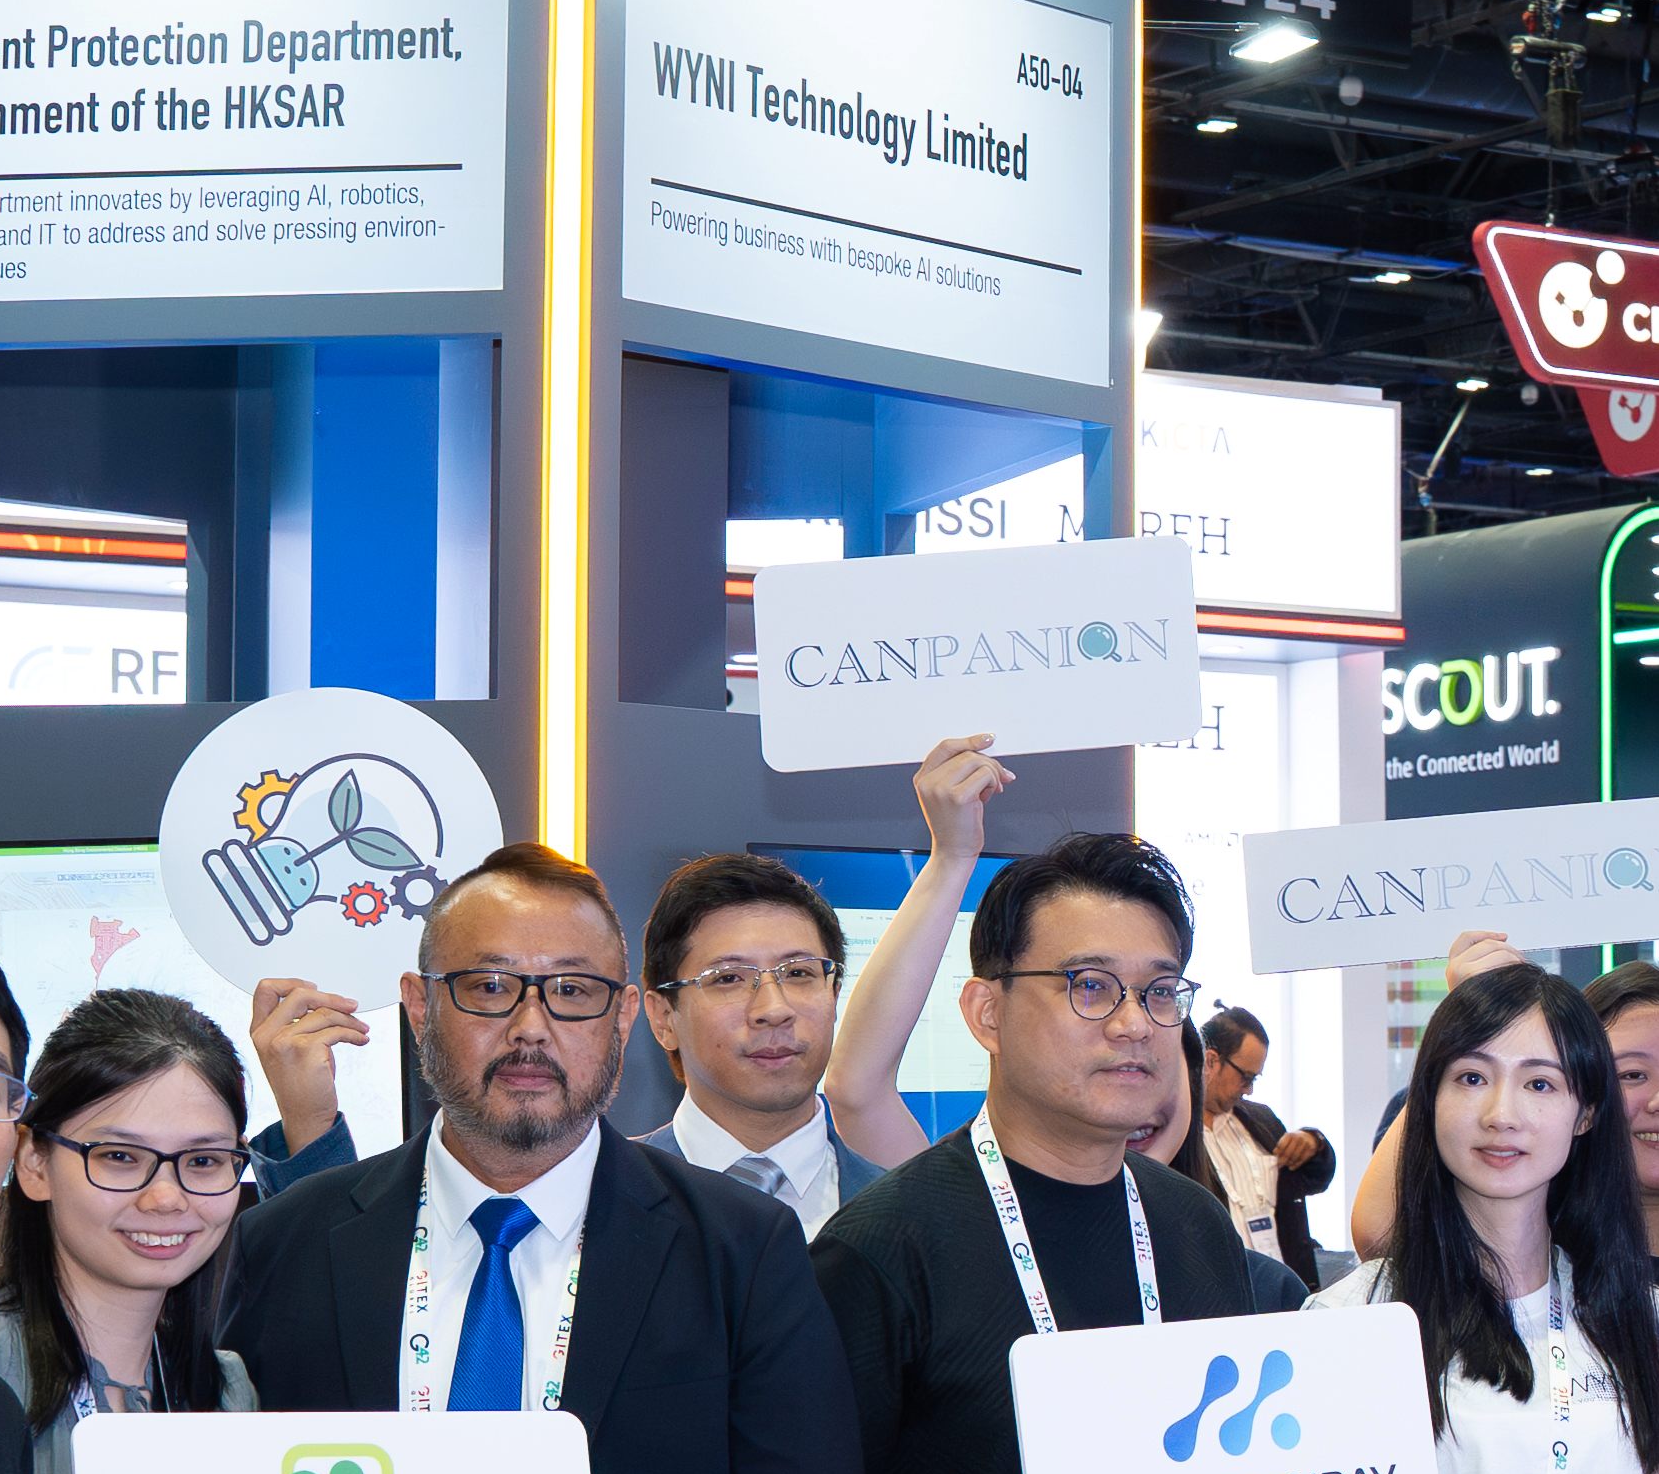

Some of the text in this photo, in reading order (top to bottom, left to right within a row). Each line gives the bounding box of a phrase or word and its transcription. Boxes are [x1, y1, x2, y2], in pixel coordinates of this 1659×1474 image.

[48, 23, 227, 68] Protection
[244, 19, 461, 70] Department,
[1017, 54, 1082, 100] A50-04
[112, 90, 145, 133] of
[155, 89, 209, 131] the
[225, 85, 344, 130] HKSAR
[654, 43, 1027, 182] WYNI Technology Limited
[71, 191, 161, 211] innovates
[171, 189, 191, 214] by
[200, 187, 299, 213] leveraging
[308, 186, 331, 209] AI,
[342, 184, 423, 206] robotics,
[40, 225, 51, 245] IT
[65, 226, 80, 245] to
[89, 224, 164, 244] address
[173, 222, 208, 243] and
[217, 221, 265, 242] solve
[274, 219, 356, 245] pressing
[365, 217, 444, 238] environ-
[652, 202, 1000, 296] Powering business with bespoke AI solutions
[1386, 740, 1559, 780] the Connected World
